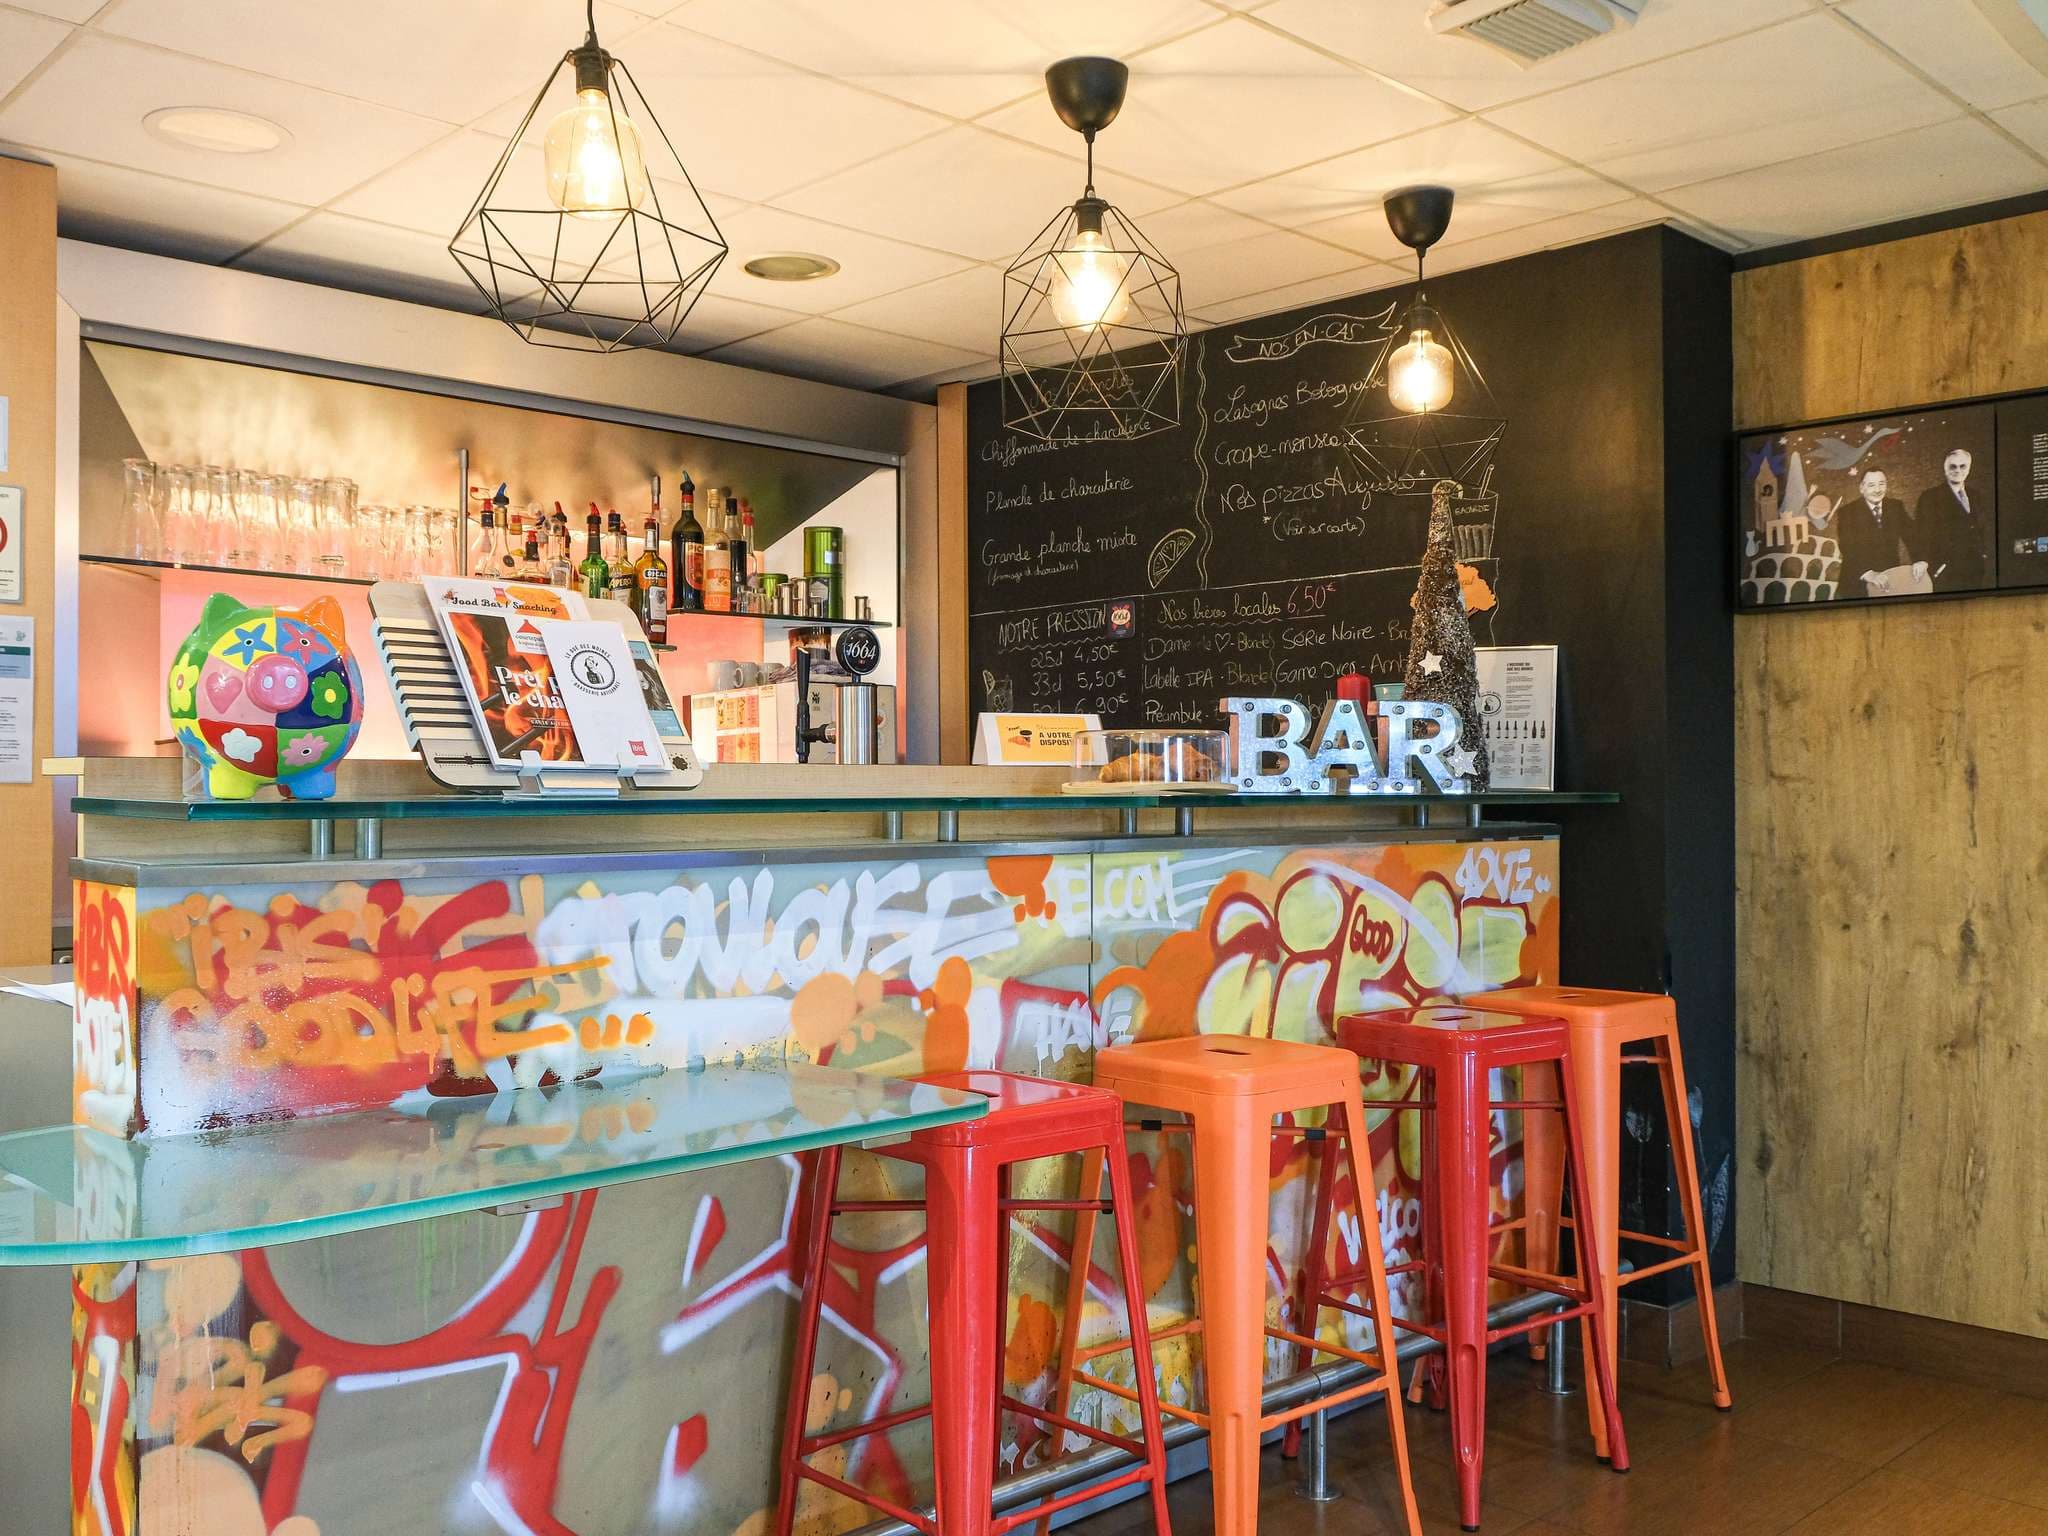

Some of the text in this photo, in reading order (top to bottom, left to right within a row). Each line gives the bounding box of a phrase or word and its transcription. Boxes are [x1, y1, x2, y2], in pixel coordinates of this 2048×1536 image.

[1259, 339, 1290, 357] NOS
[1039, 481, 1056, 503] de
[1060, 469, 1135, 499] charcuterie
[1220, 483, 1257, 514] Nos
[1263, 480, 1325, 514] pizzas
[687, 544, 704, 553] PIC
[981, 538, 1032, 567] Grande
[1037, 525, 1091, 565] planche
[512, 601, 557, 615] Snacking
[1158, 598, 1188, 624] Nos
[1234, 591, 1281, 618] locales
[998, 617, 1040, 647] NOTRE
[1332, 620, 1376, 641] Noire
[846, 639, 877, 660] 1664
[1144, 637, 1192, 661] Dame
[494, 665, 546, 689] Prêt
[1142, 663, 1182, 689] Labelle
[1185, 668, 1215, 689] IPA
[500, 685, 522, 706] le
[526, 687, 566, 709] cha
[1219, 697, 1473, 796] BAR
[1350, 904, 1394, 965] GOOD
